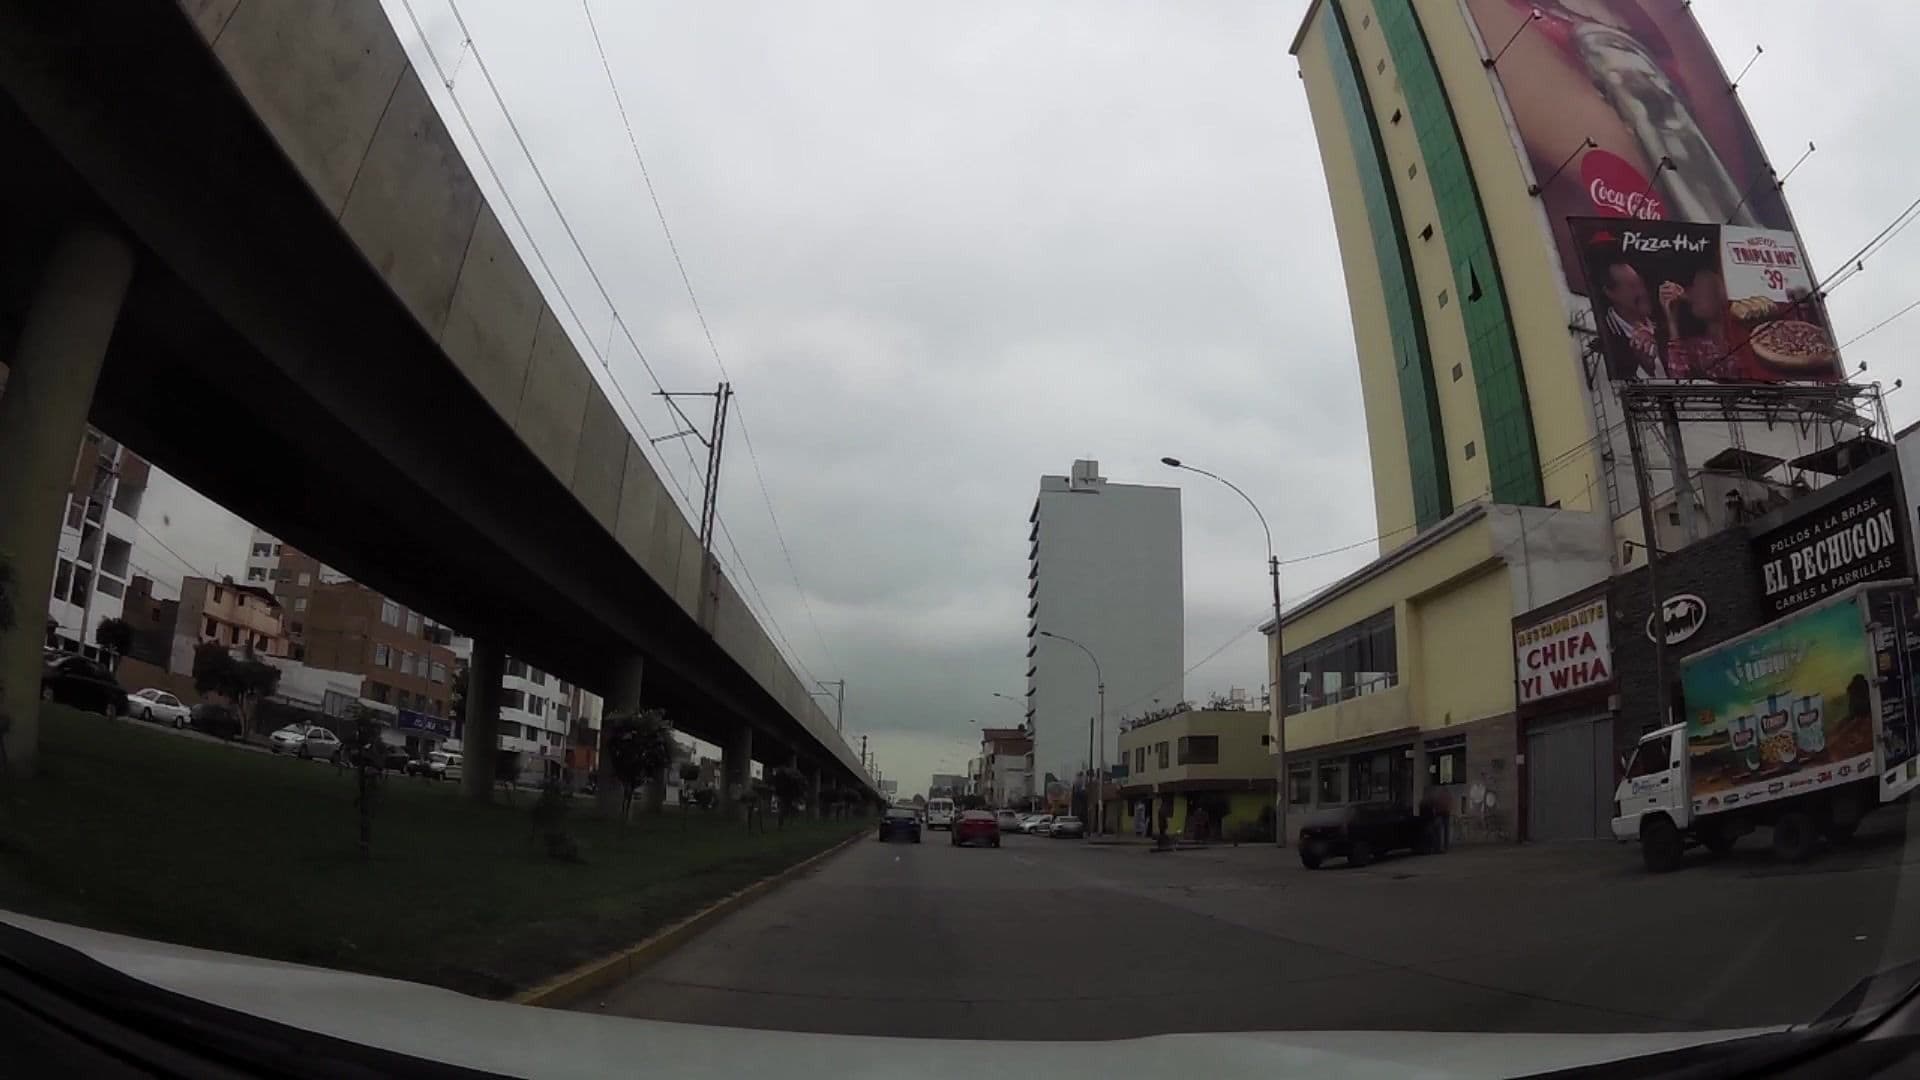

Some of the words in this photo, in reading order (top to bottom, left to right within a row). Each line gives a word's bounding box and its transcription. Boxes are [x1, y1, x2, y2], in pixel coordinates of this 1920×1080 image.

[1590, 177, 1627, 215] Coca
[1626, 191, 1661, 220] Cola
[1622, 231, 1671, 253] Pizza
[1671, 233, 1711, 253] Hut
[1732, 247, 1774, 264] TRIPLE
[1774, 250, 1798, 266] HUT
[1769, 528, 1811, 553] POLLOS
[1814, 523, 1822, 535] A
[1824, 515, 1838, 530] LA
[1840, 496, 1879, 522] BRASA
[1762, 558, 1789, 596] EL
[1789, 507, 1896, 586] PECHUGON
[1775, 586, 1817, 611] CARNES
[1831, 555, 1892, 590] PARRILLAS
[1518, 604, 1604, 648] RESTAURANTE
[1526, 631, 1597, 670] CHIFA
[1520, 675, 1542, 699] YI
[1549, 657, 1608, 691] WHA
